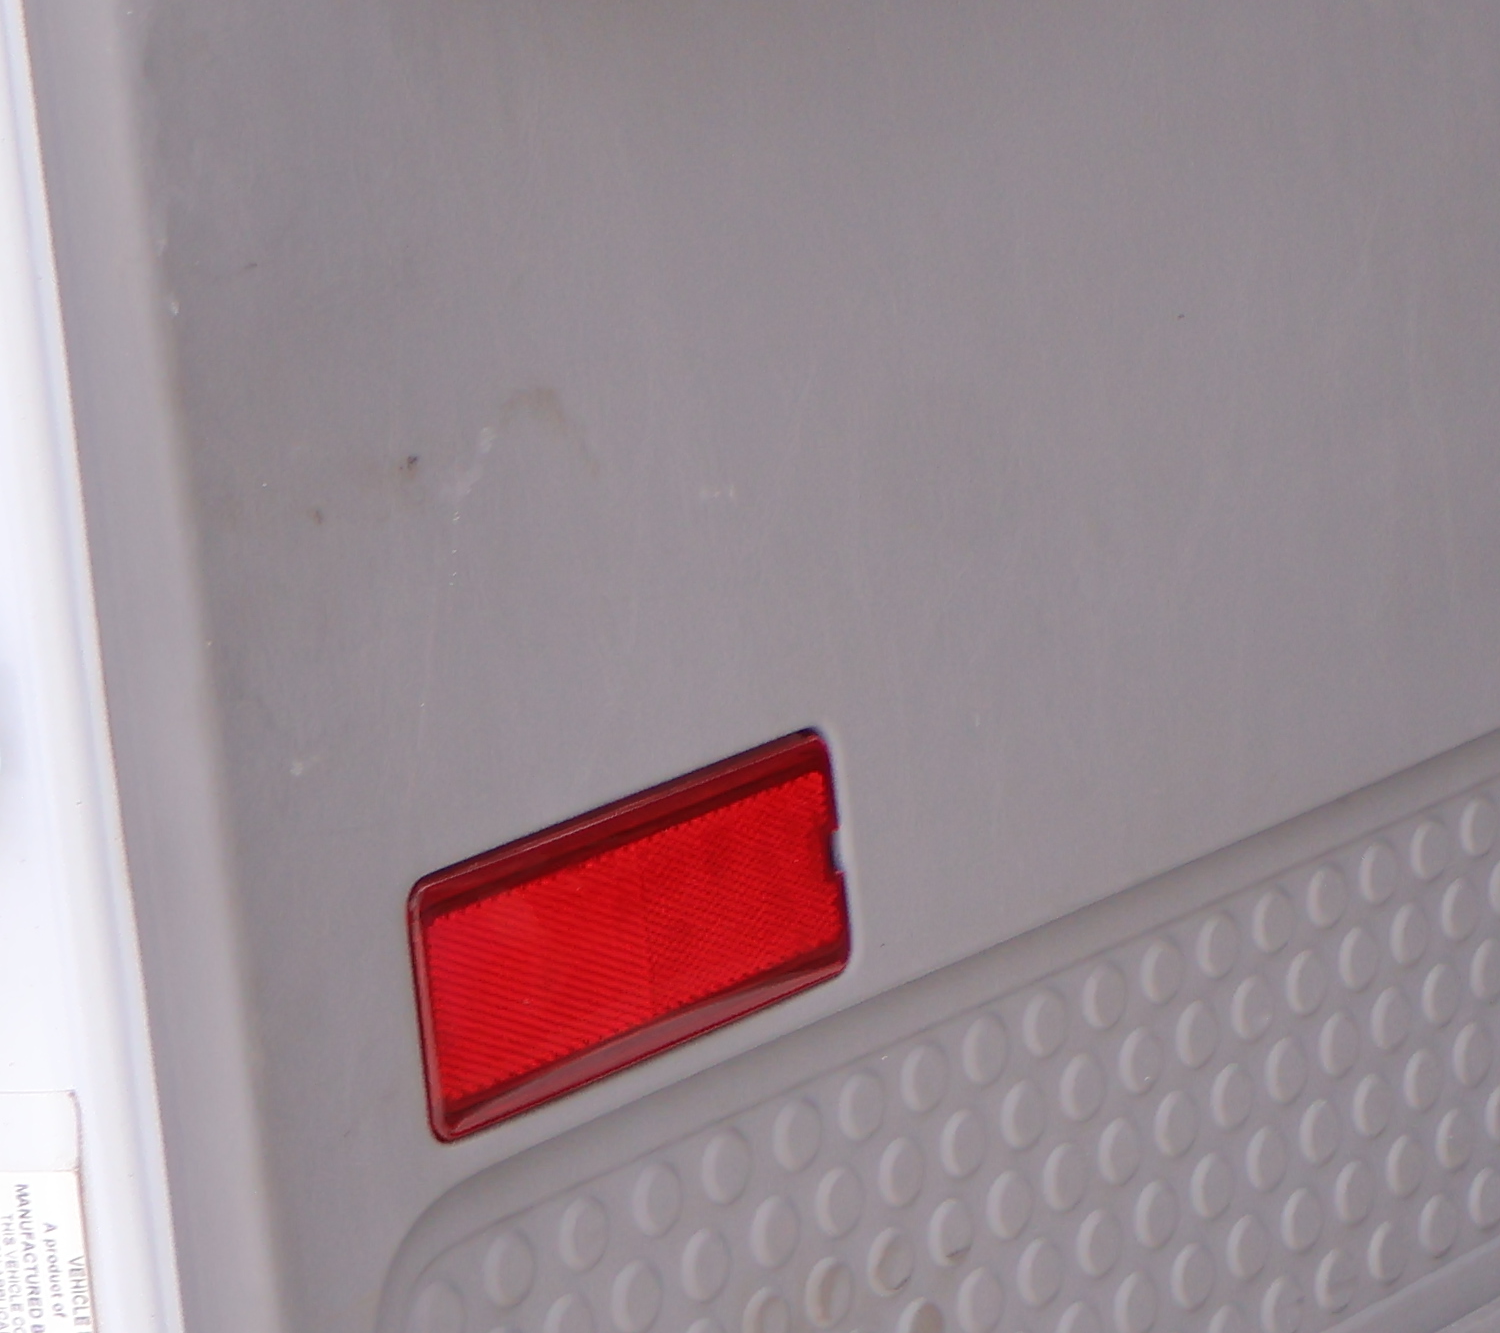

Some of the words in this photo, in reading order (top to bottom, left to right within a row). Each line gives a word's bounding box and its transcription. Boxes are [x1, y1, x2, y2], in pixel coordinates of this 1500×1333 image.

[14, 1183, 44, 1319] MANUFACTURED
[42, 1238, 64, 1299] product
[68, 1254, 92, 1326] VEHICLE
